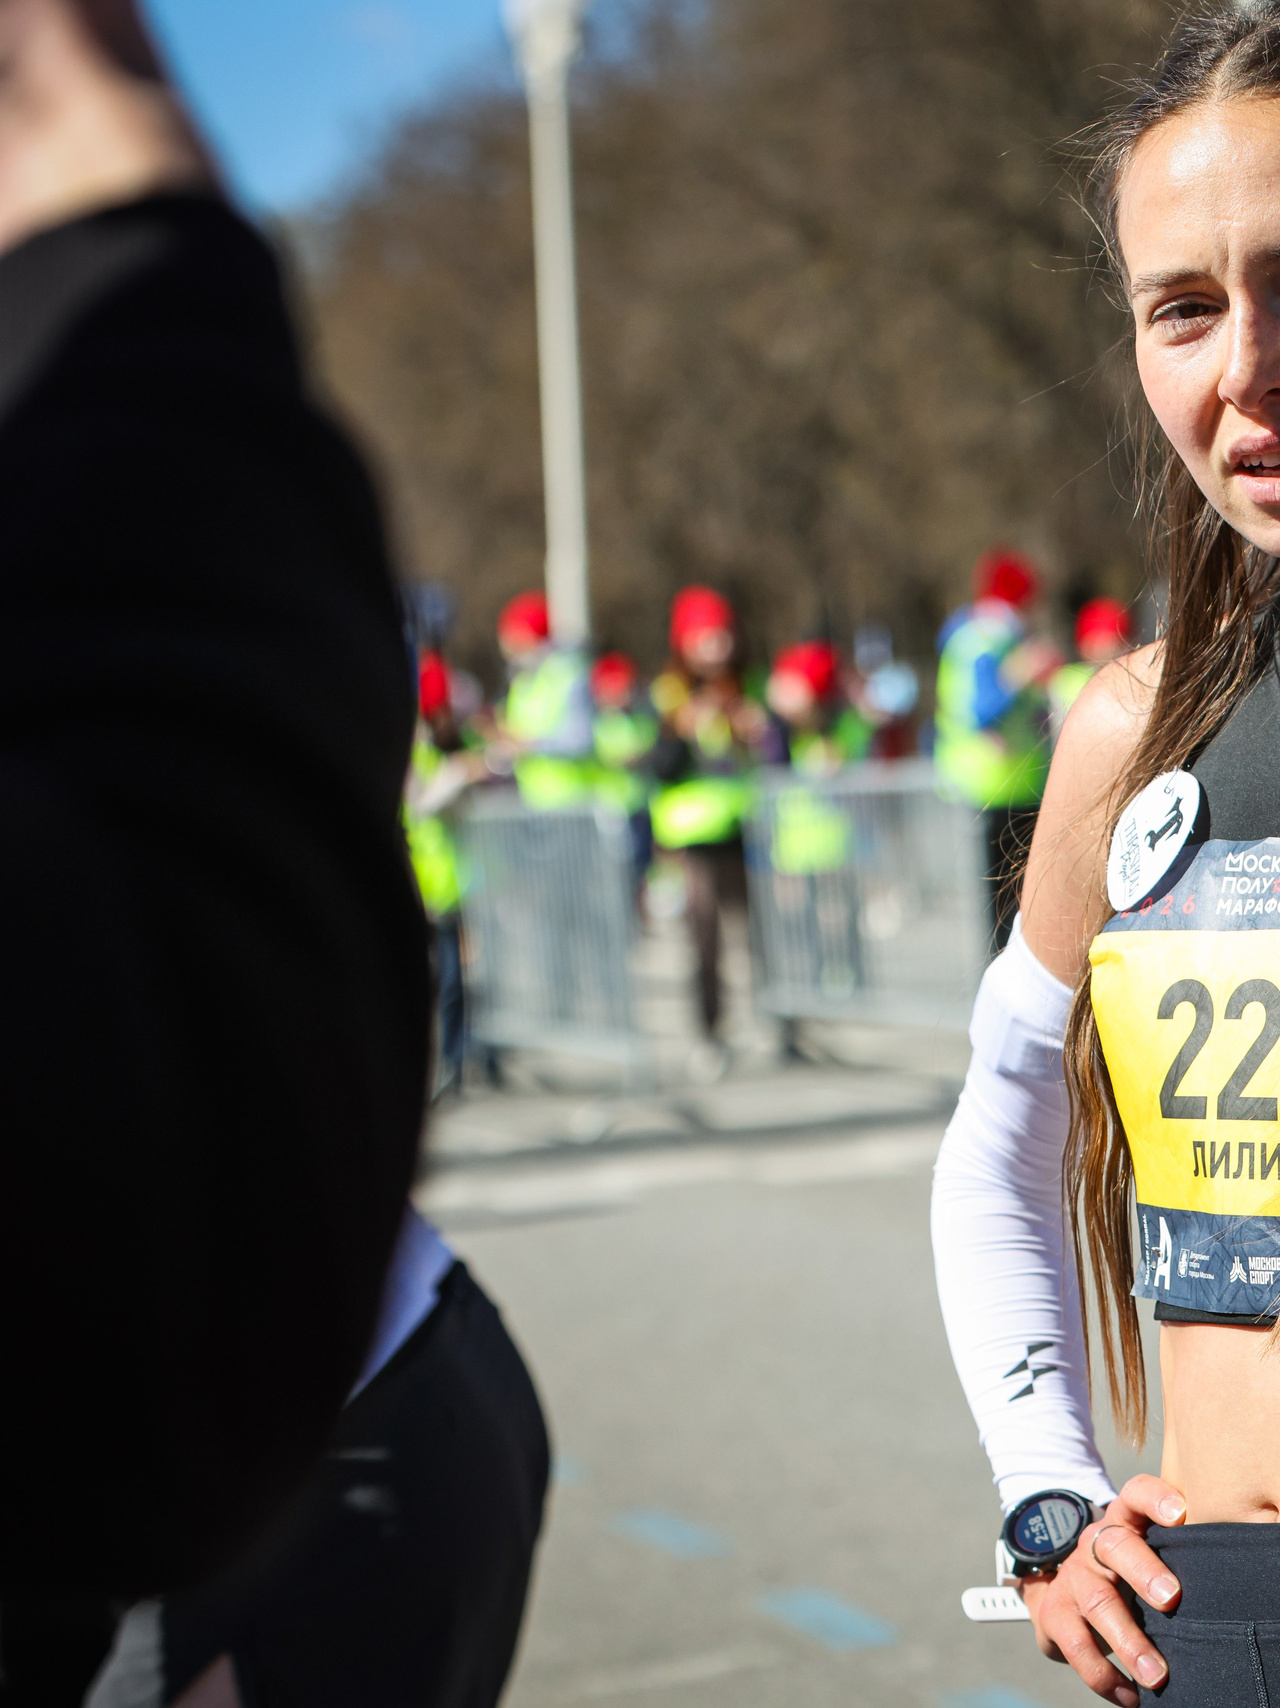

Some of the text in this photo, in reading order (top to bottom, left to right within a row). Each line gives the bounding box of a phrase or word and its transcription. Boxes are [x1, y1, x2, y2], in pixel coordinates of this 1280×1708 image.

[1220, 876, 1275, 895] ПОЛУ
[1249, 1270, 1274, 1285] СПОРТ
[1028, 1514, 1049, 1545] 2:58
